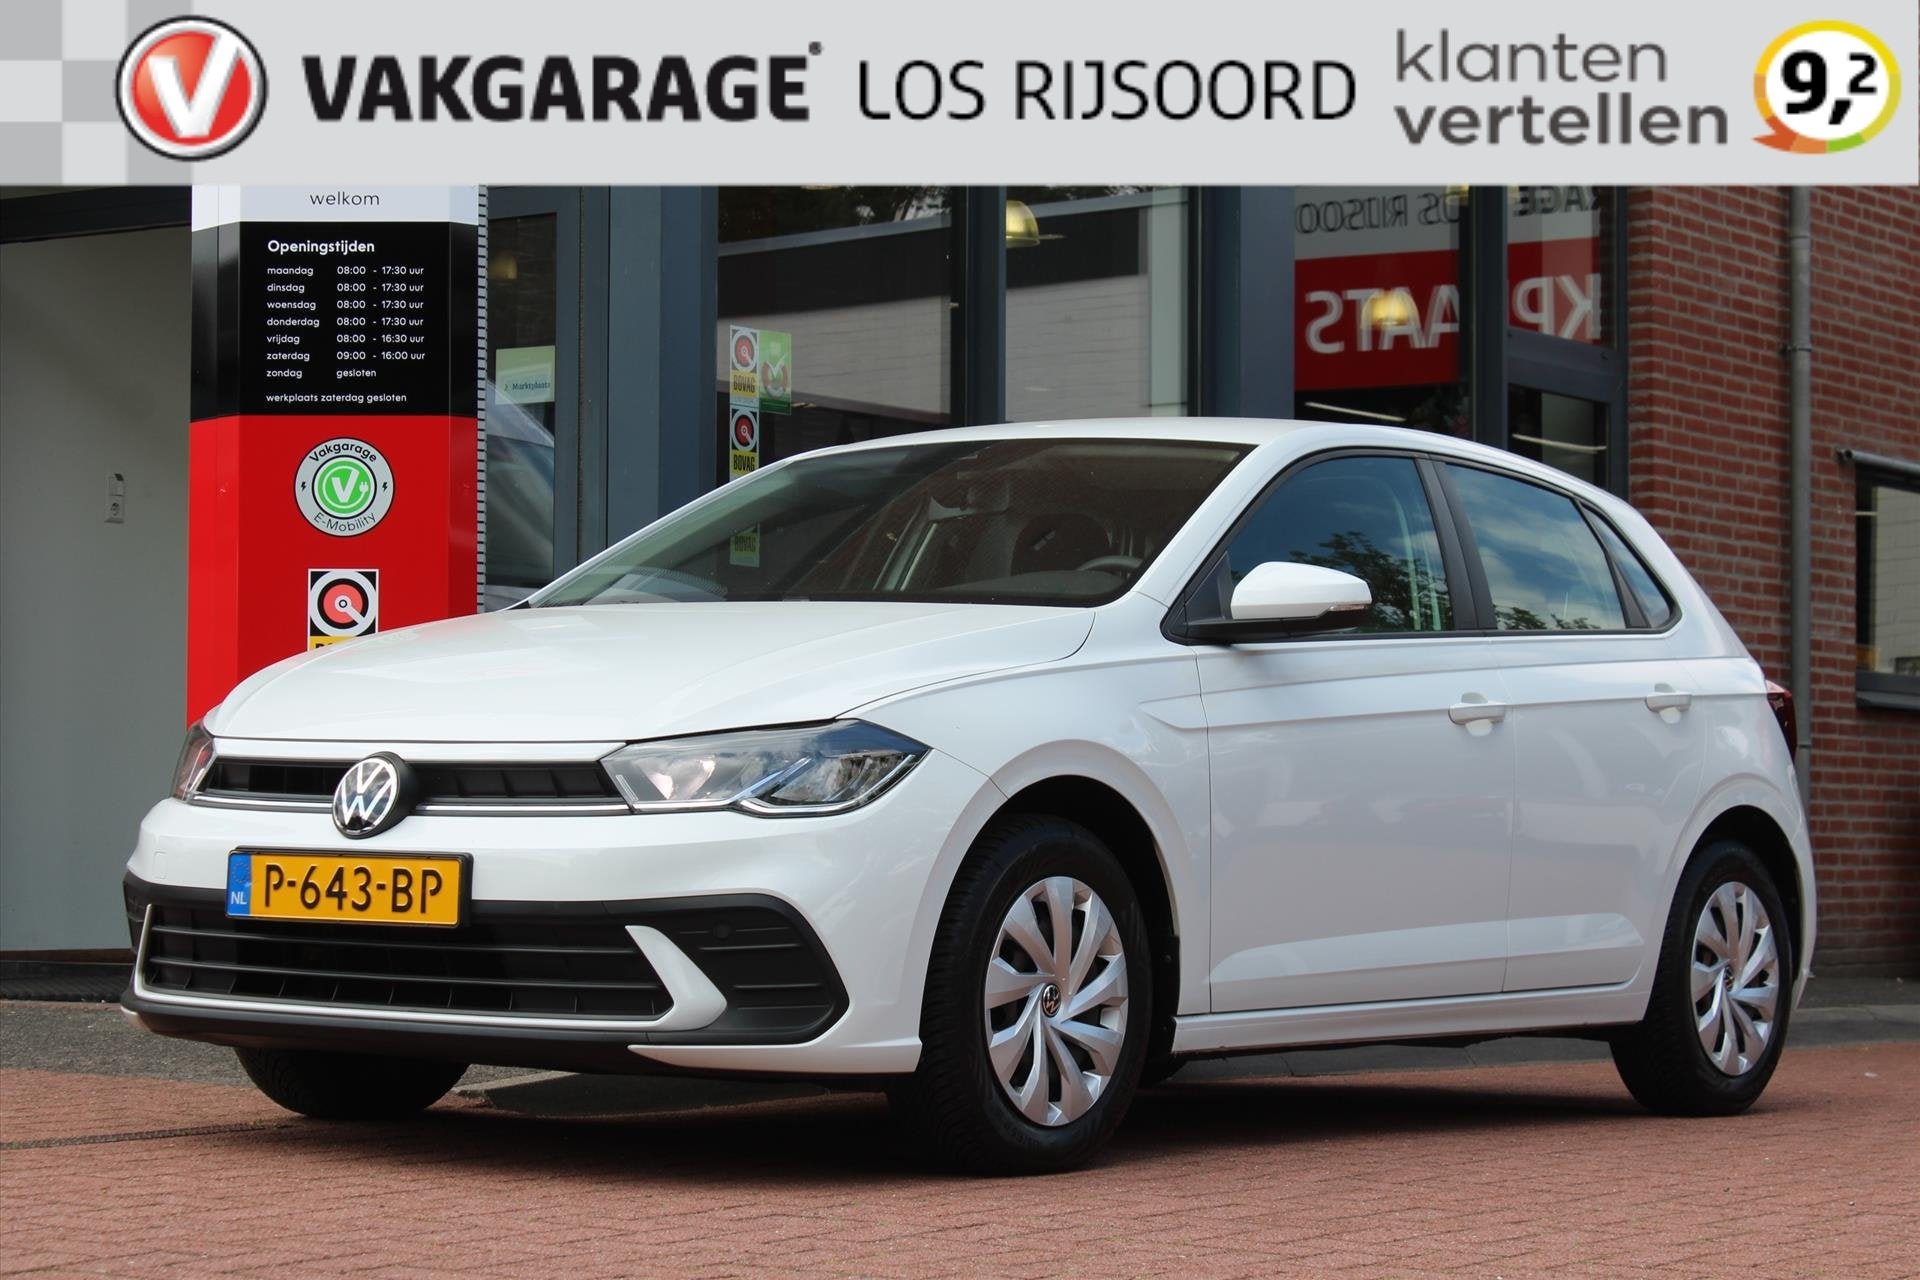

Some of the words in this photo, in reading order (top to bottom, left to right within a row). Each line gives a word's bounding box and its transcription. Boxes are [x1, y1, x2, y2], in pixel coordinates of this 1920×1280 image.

[309, 191, 380, 206] welkom
[267, 239, 375, 256] Openingstijden
[267, 266, 313, 277] maandag
[336, 266, 367, 275] 08:00
[381, 266, 407, 275] 17:30
[409, 267, 424, 275] uur
[267, 283, 305, 294] dinsdag
[336, 283, 367, 292] 08:00
[381, 283, 407, 292] 17:30
[409, 284, 424, 292] uur
[266, 300, 317, 311] woensdag
[336, 300, 367, 309] 08:00
[381, 300, 407, 309] 17:30
[408, 301, 424, 309] uur
[266, 317, 320, 328] donderdag
[336, 317, 367, 326] 08:00
[381, 317, 407, 326] 17:30
[408, 318, 424, 326] uur
[266, 334, 300, 345] vrijdag
[336, 334, 367, 343] 08:00
[381, 334, 408, 343] 16:30
[409, 335, 425, 343] uur
[266, 351, 310, 362] zaterdag
[336, 351, 367, 360] 09:00
[381, 351, 409, 360] 16:00
[410, 352, 426, 360] uur
[266, 368, 303, 379] zondag
[336, 368, 377, 379] gesloten
[733, 374, 756, 393] BOVAG
[266, 393, 319, 404] werkplaats
[320, 393, 365, 404] zaterdag
[366, 393, 407, 404] gesloten
[309, 441, 378, 463] Vakgarage
[733, 454, 756, 472] BOVAG
[314, 511, 377, 533] E-Mobility
[264, 863, 444, 914] P-643-BP
[230, 891, 248, 906] NL
